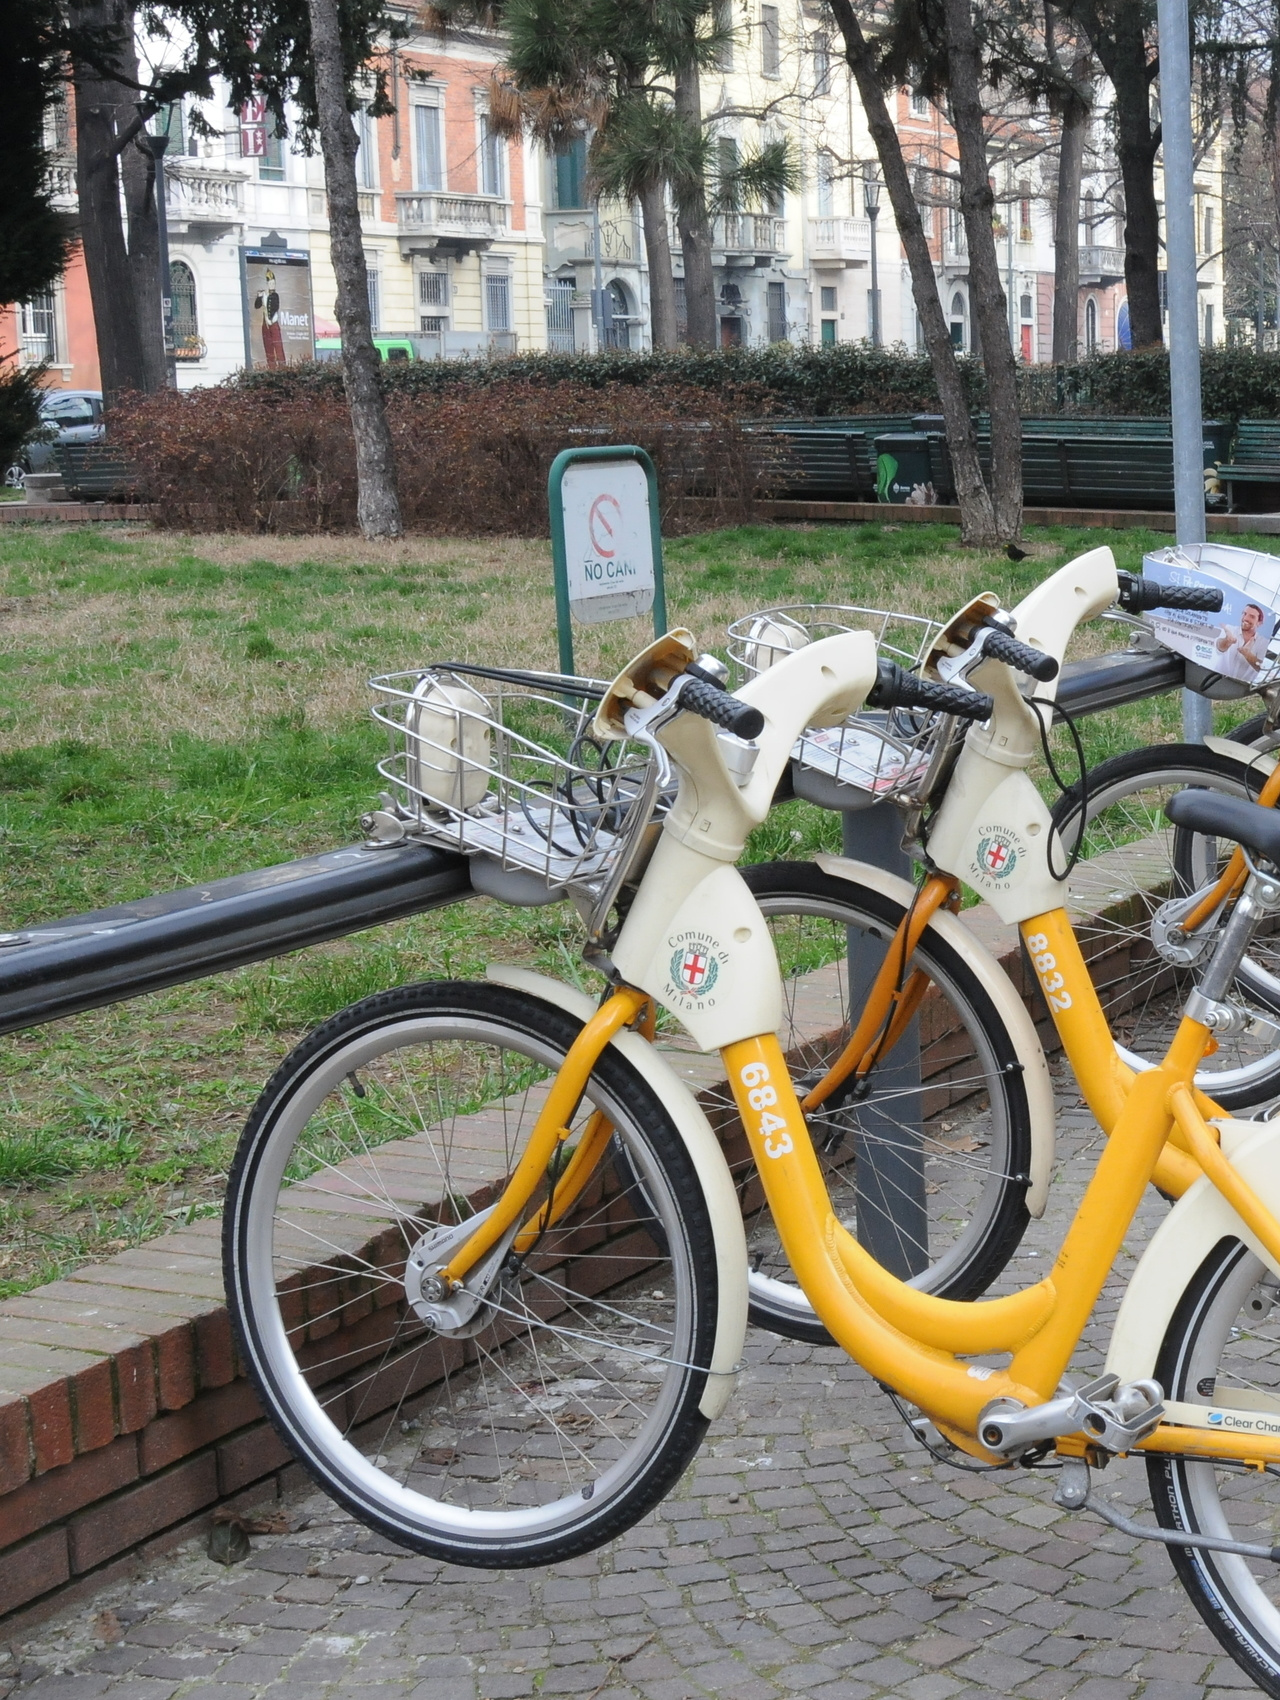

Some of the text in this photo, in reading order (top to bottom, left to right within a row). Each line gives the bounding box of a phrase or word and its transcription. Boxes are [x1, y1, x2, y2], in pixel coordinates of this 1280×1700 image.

[280, 311, 309, 326] Manet
[584, 563, 603, 581] NO
[978, 825, 1027, 858] Comune di
[968, 862, 1011, 890] Milano
[668, 931, 729, 965] Comune di
[1027, 933, 1073, 1013] 8832
[663, 983, 716, 1010] Milano
[740, 1062, 794, 1159] 6843
[1224, 1415, 1254, 1429] Clear
[1168, 1485, 1193, 1558] MATHON
[1218, 1610, 1278, 1678] SCHWALBE
